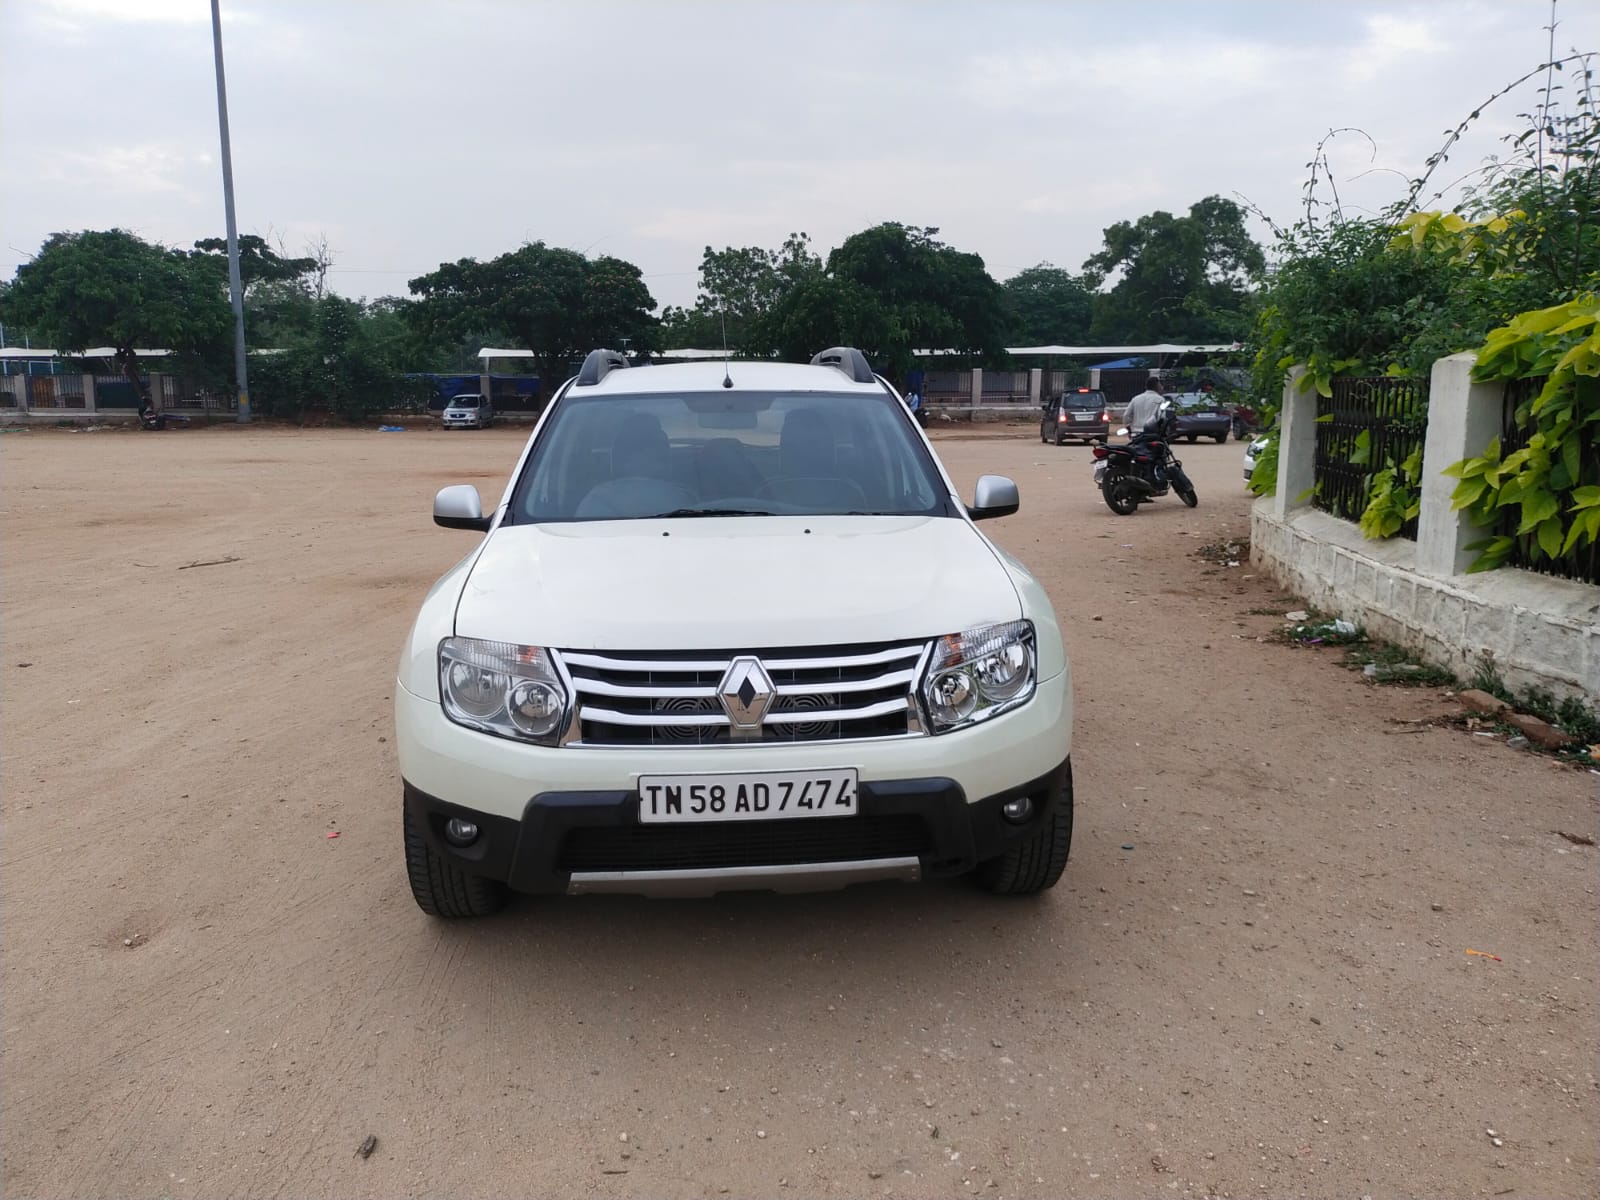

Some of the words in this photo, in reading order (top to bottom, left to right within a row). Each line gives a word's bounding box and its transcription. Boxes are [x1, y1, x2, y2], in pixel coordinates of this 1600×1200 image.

[646, 785, 682, 814] TN
[689, 784, 726, 814] 58
[734, 783, 770, 812] AD
[778, 778, 851, 811] 7474
